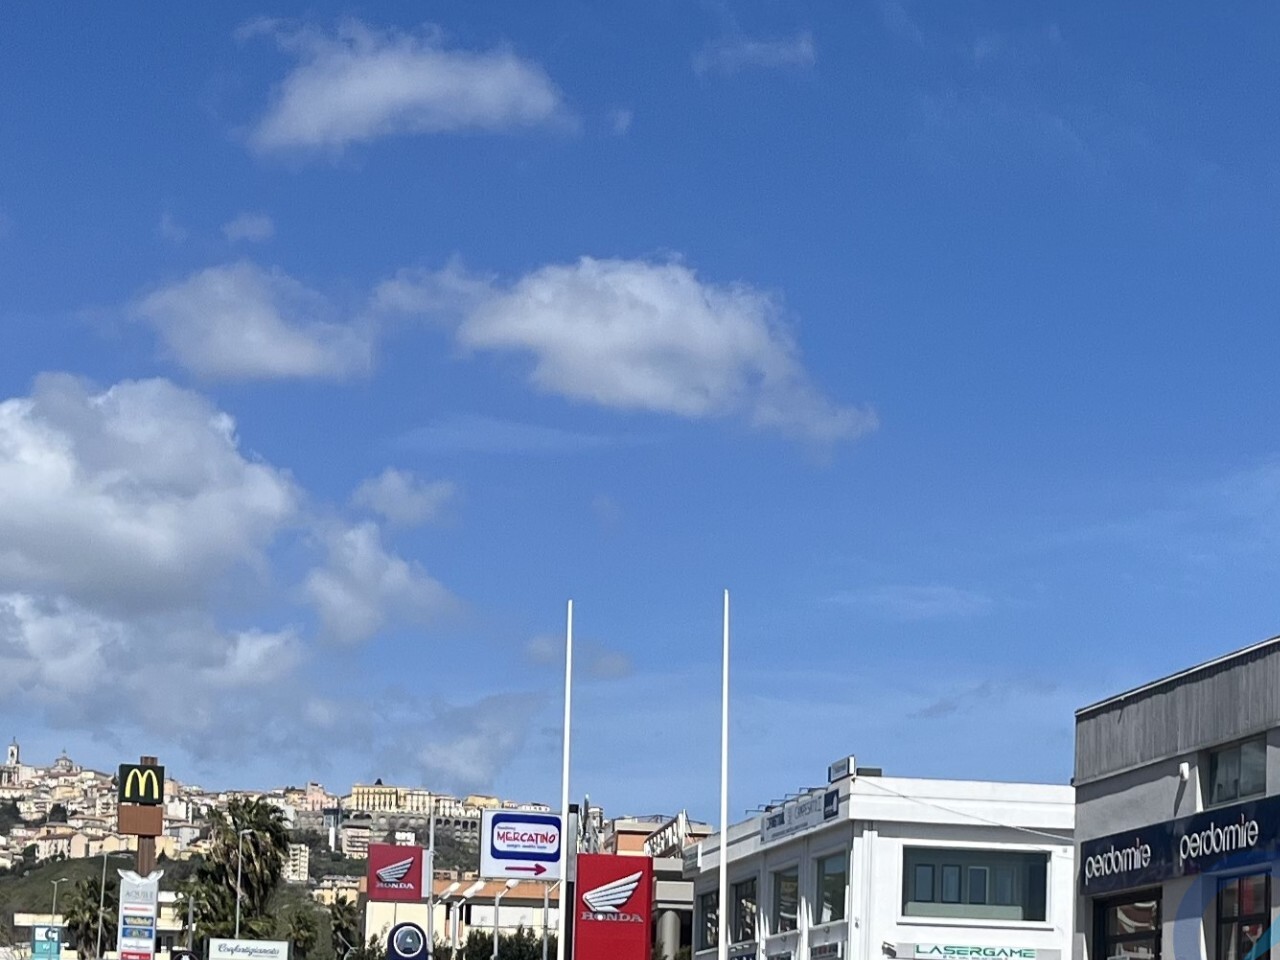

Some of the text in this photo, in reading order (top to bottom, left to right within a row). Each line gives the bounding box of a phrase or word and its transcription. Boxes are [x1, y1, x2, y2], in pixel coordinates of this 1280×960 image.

[497, 831, 556, 844] MERCATINO
[1179, 813, 1259, 867] perdormire
[1084, 837, 1151, 885] perdormire
[376, 882, 414, 890] HONDA
[581, 911, 643, 923] HONDA
[915, 944, 1036, 959] LASERGAME
